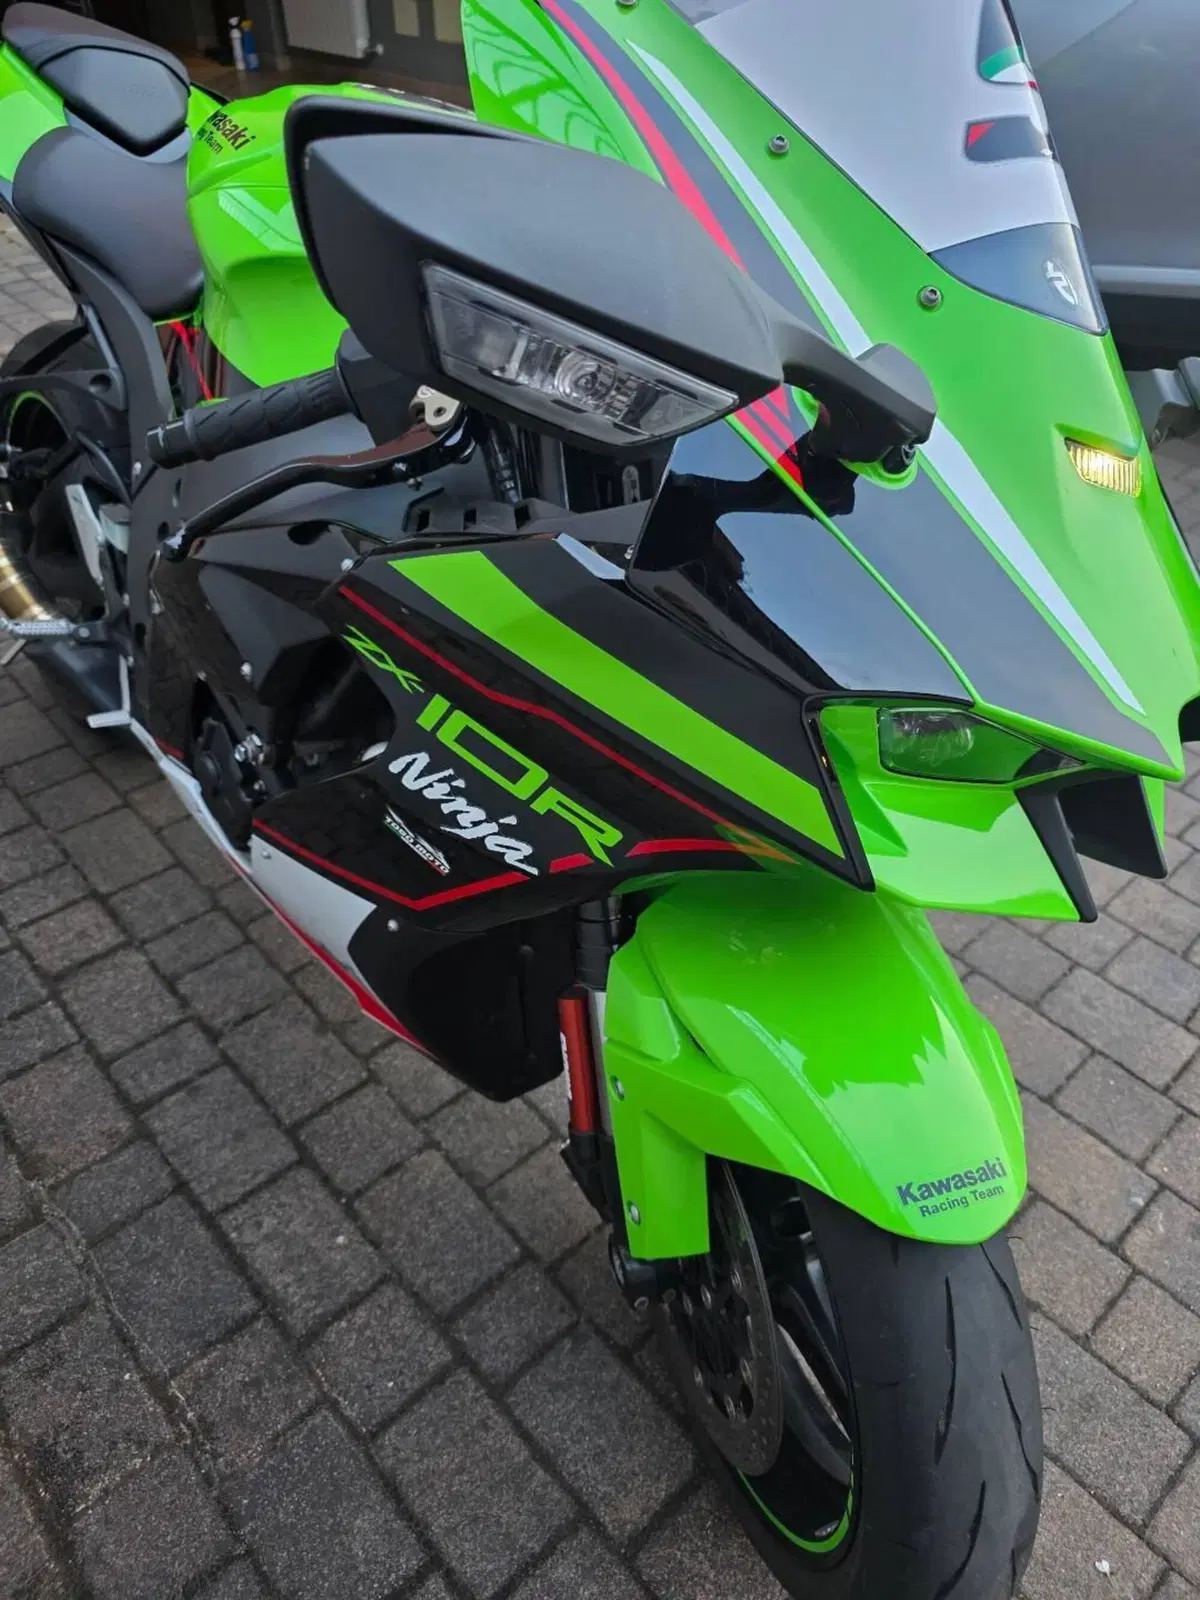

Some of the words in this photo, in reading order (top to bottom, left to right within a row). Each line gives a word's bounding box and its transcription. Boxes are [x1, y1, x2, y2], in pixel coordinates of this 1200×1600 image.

[388, 752, 539, 876] Ninja
[896, 1157, 1007, 1206] Kawasaki
[919, 1194, 969, 1218] Racing
[970, 1184, 1004, 1201] Team
